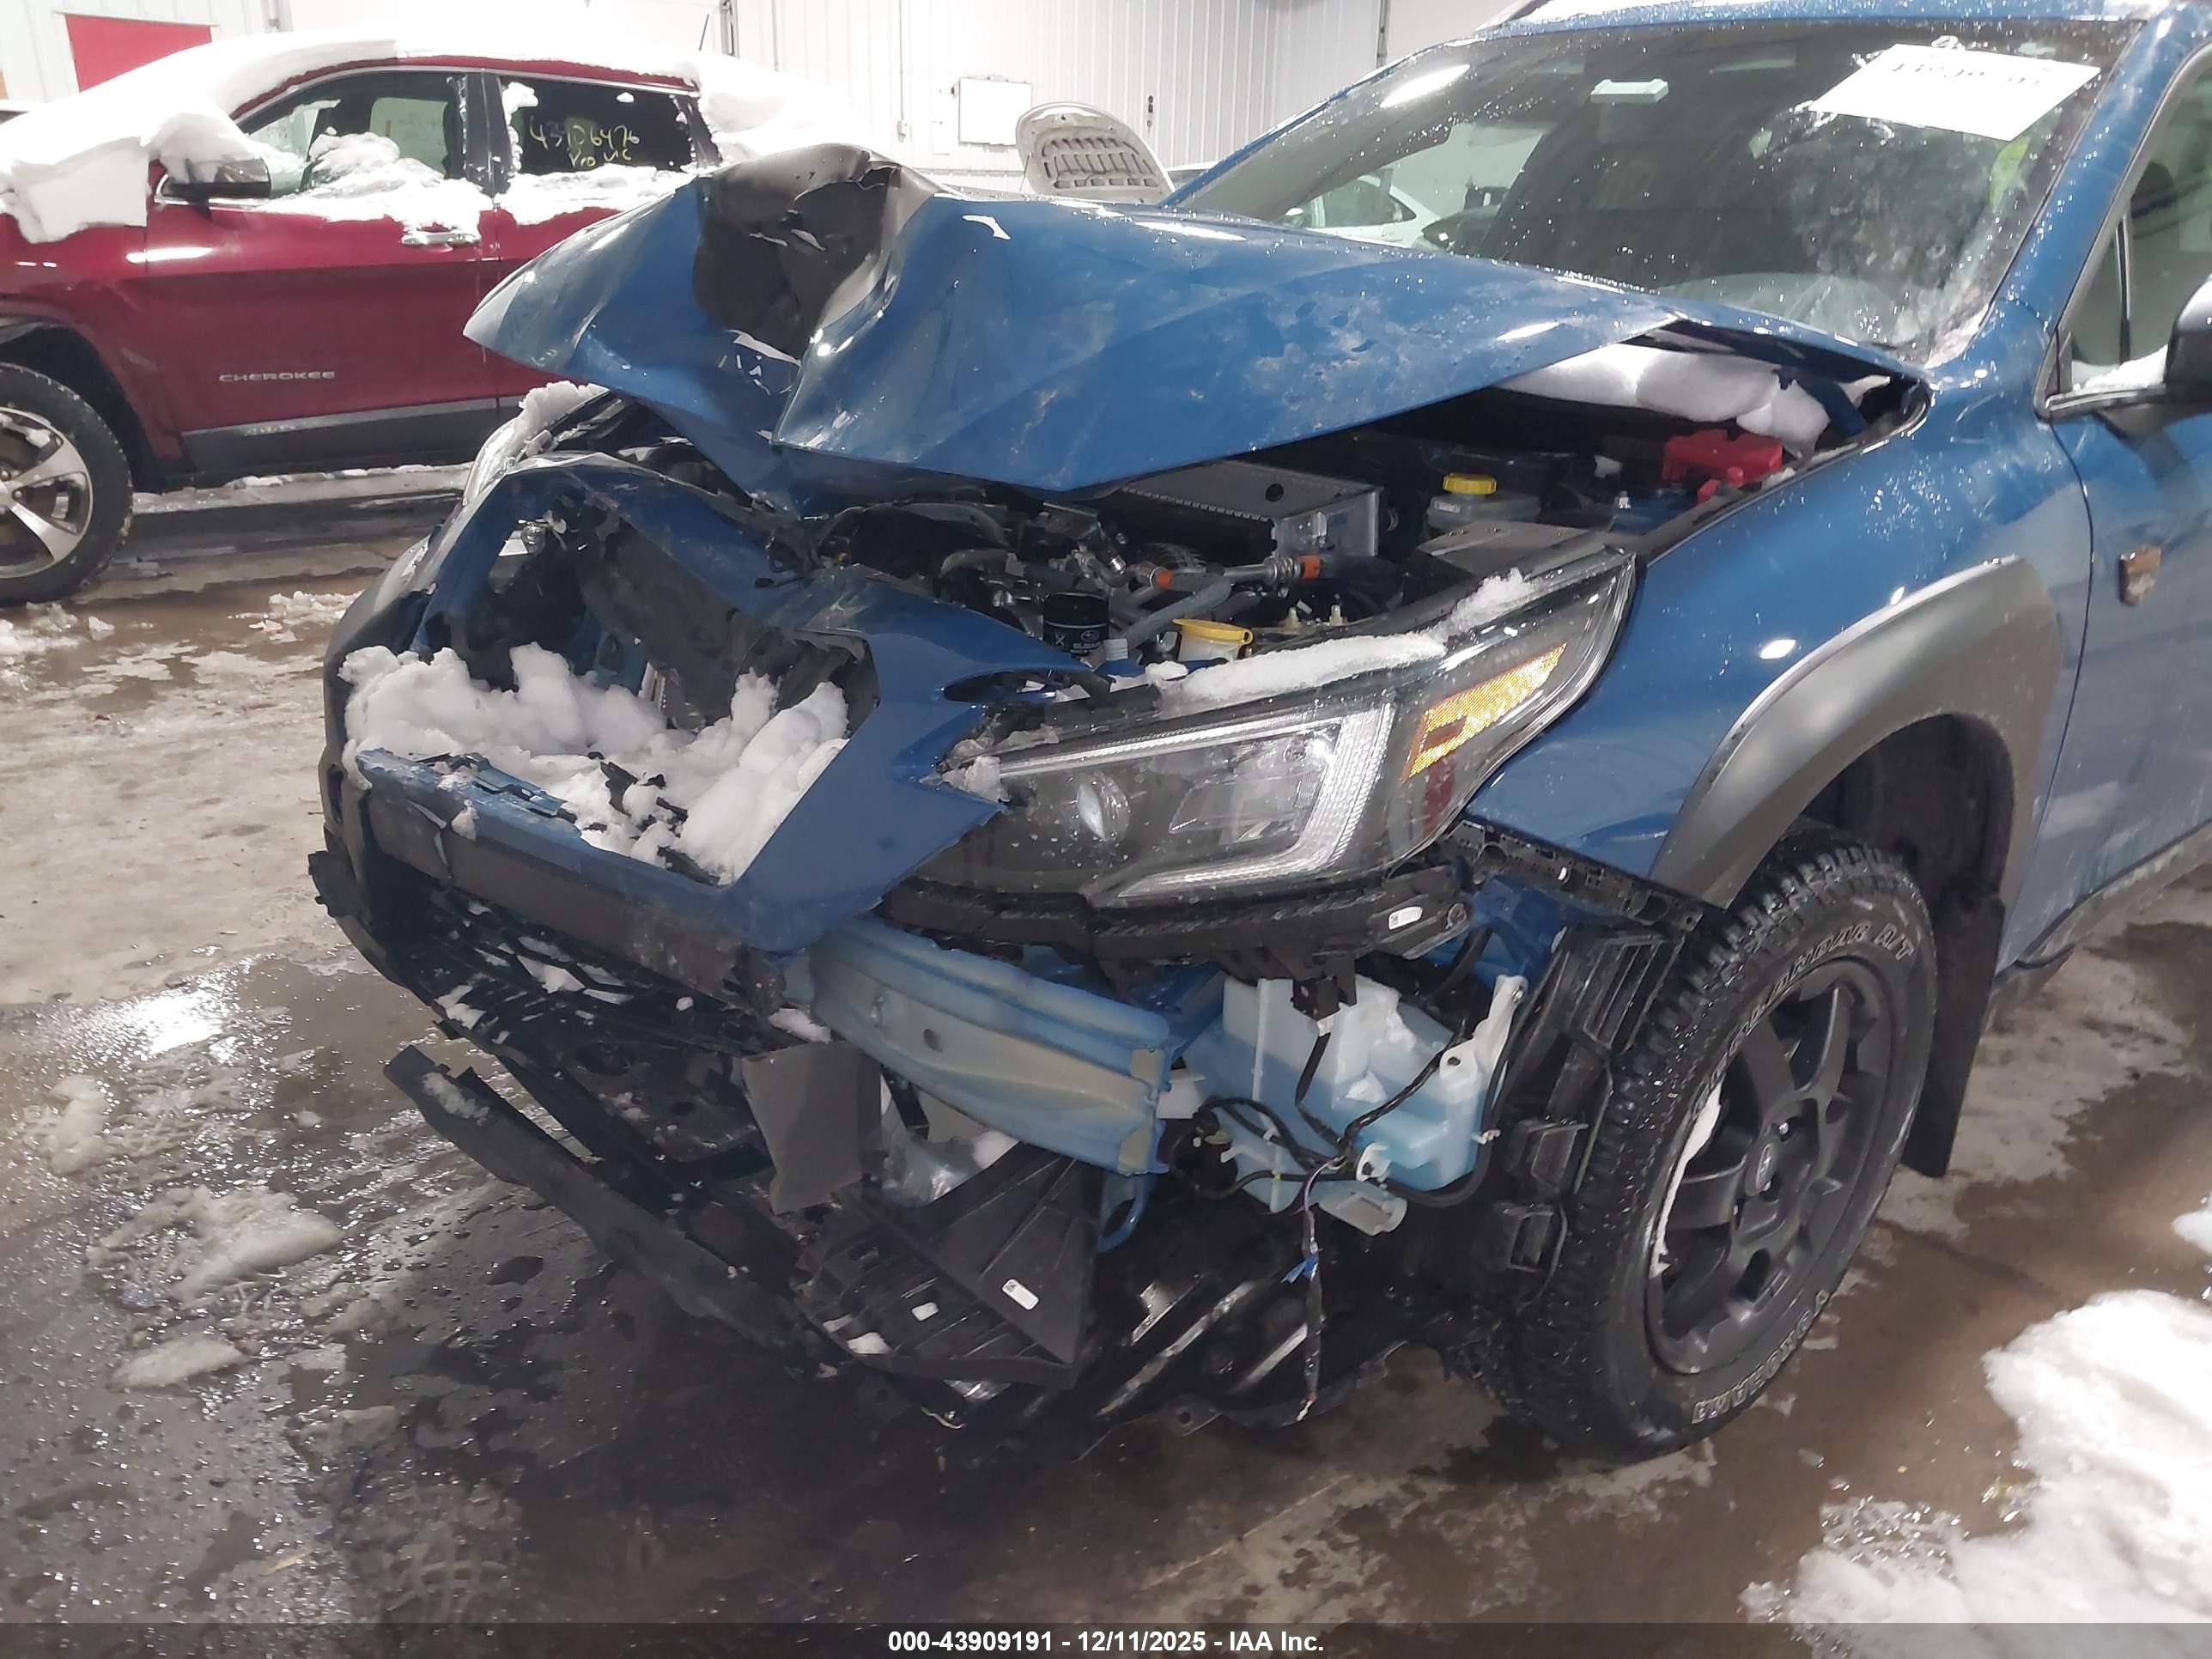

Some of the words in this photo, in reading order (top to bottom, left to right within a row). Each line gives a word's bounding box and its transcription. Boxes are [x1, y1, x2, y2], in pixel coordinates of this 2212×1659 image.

[218, 371, 335, 382] CHEROKEE
[1874, 922, 1915, 961] A/T
[1691, 1289, 1830, 1424] YOKOHAMA
